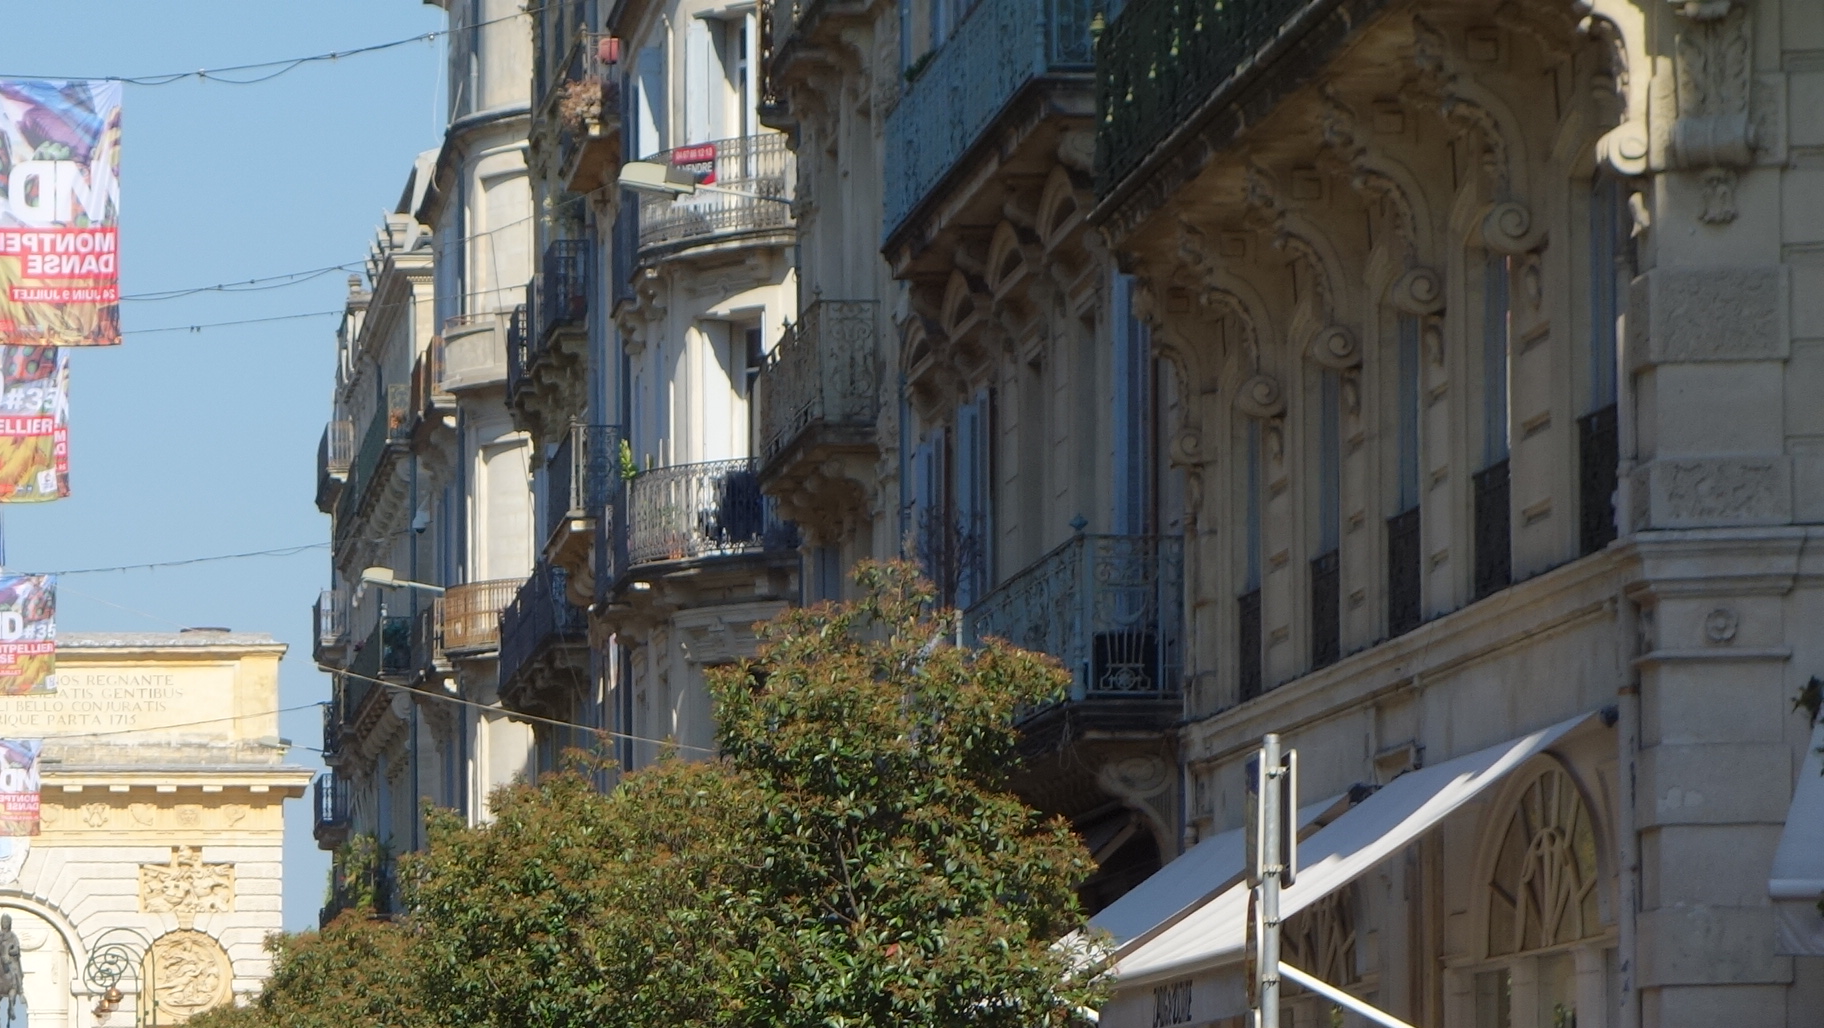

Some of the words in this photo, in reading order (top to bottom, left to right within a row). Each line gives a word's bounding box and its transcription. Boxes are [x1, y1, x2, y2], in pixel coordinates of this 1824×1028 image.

[86, 674, 174, 686] REGNANTE
[102, 688, 184, 699] GENTIBUS
[16, 701, 64, 712] BELLO
[72, 700, 167, 712] CONJURATIS
[48, 714, 101, 725] PARTA
[110, 714, 136, 725] 1715
